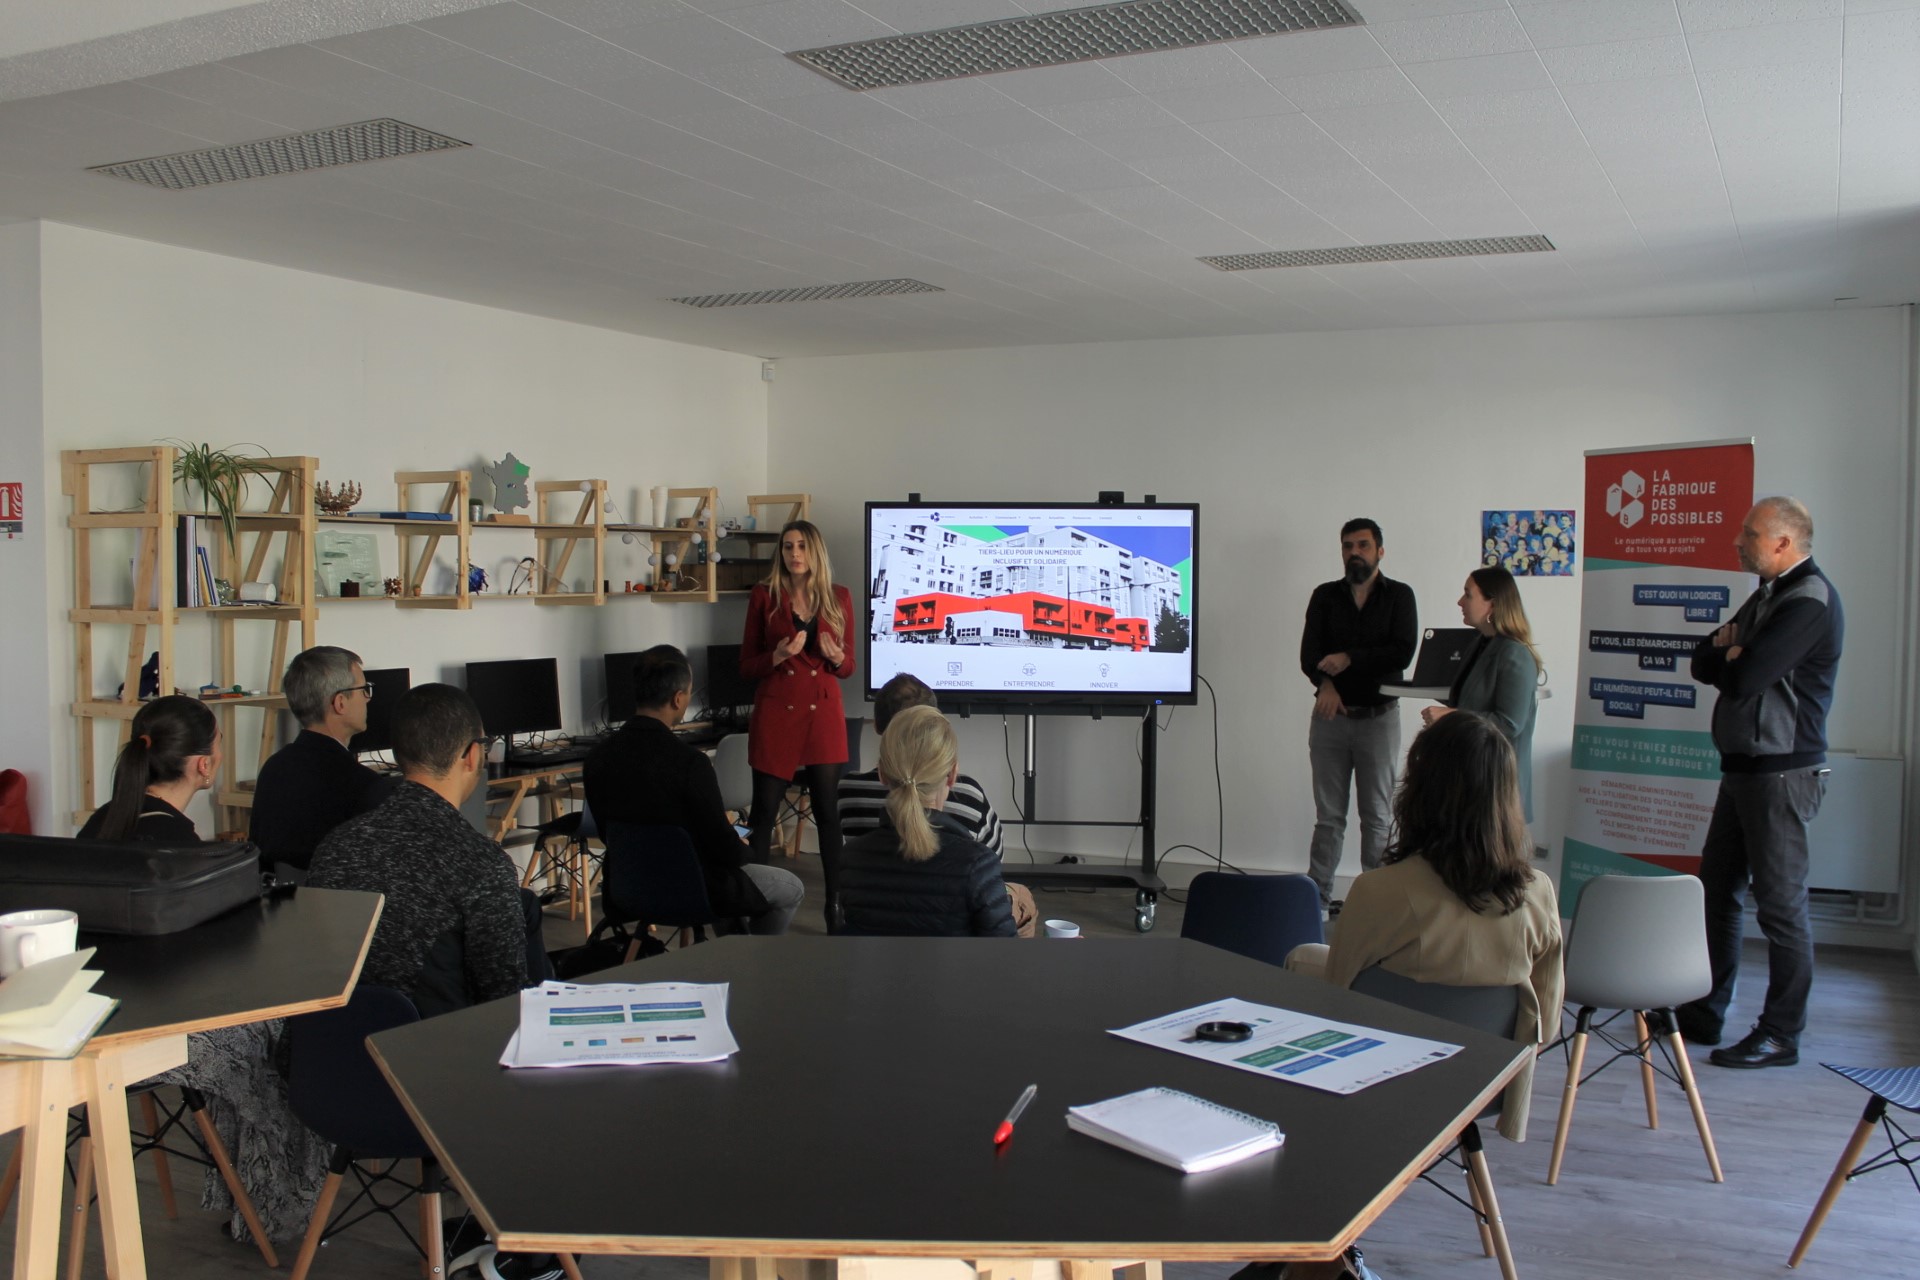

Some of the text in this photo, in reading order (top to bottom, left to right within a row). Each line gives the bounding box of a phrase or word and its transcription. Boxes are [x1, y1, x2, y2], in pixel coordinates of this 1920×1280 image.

[1653, 470, 1671, 482] LA
[1652, 481, 1716, 496] FABRIQUE
[1651, 498, 1677, 511] DES
[1650, 511, 1723, 525] POSSIBLES
[1614, 537, 1624, 545] Le
[1625, 536, 1664, 546] numérique
[1678, 536, 1706, 544] service
[1015, 548, 1033, 556] POUR
[1045, 548, 1082, 556] NUMÉRIQUE
[1669, 545, 1696, 555] projets
[1638, 590, 1723, 601] C'EST QUOI UN LOGICIEL
[1686, 608, 1714, 618] LIBRE ?
[1591, 636, 1600, 645] ET
[1600, 636, 1621, 647] VOUS,
[1622, 638, 1635, 647] LES
[1636, 637, 1681, 650] DÉMARCHES
[1682, 641, 1692, 650] EN
[1642, 656, 1672, 667] ÇA VA ?
[935, 680, 974, 688] APPRENDRE
[1003, 680, 1055, 688] ENTREPRENDRE
[1593, 683, 1603, 692] LE
[1603, 683, 1643, 695] NUMÉRIQUE
[1644, 686, 1672, 698] PEUT-IL
[1609, 700, 1640, 712] SOCIAL ?
[1580, 735, 1720, 760] ET SI VOUS VENIEZ DÉCOUVRI
[1589, 747, 1612, 757] TOUT
[1615, 751, 1627, 762] ÇA
[1640, 754, 1652, 763] LA
[1655, 756, 1702, 770] FABRIQUE
[1706, 762, 1712, 772] ?
[1637, 785, 1694, 800] ADMINISTRATIVES
[1585, 797, 1613, 808] ATELIERS
[1614, 800, 1650, 814] D'INITIATION
[1656, 808, 1673, 818] MISE
[1674, 811, 1684, 819] EN
[1640, 796, 1652, 804] DES
[1653, 797, 1676, 808] OUTILS
[1677, 801, 1715, 814] NUMÉRIQUE
[1595, 809, 1695, 832] ACCOMPAGNEMENT DES PROJETS
[1600, 818, 1690, 841] PÔLE MICRO-ENTREPRENEURS
[1602, 829, 1638, 842] COWORKING
